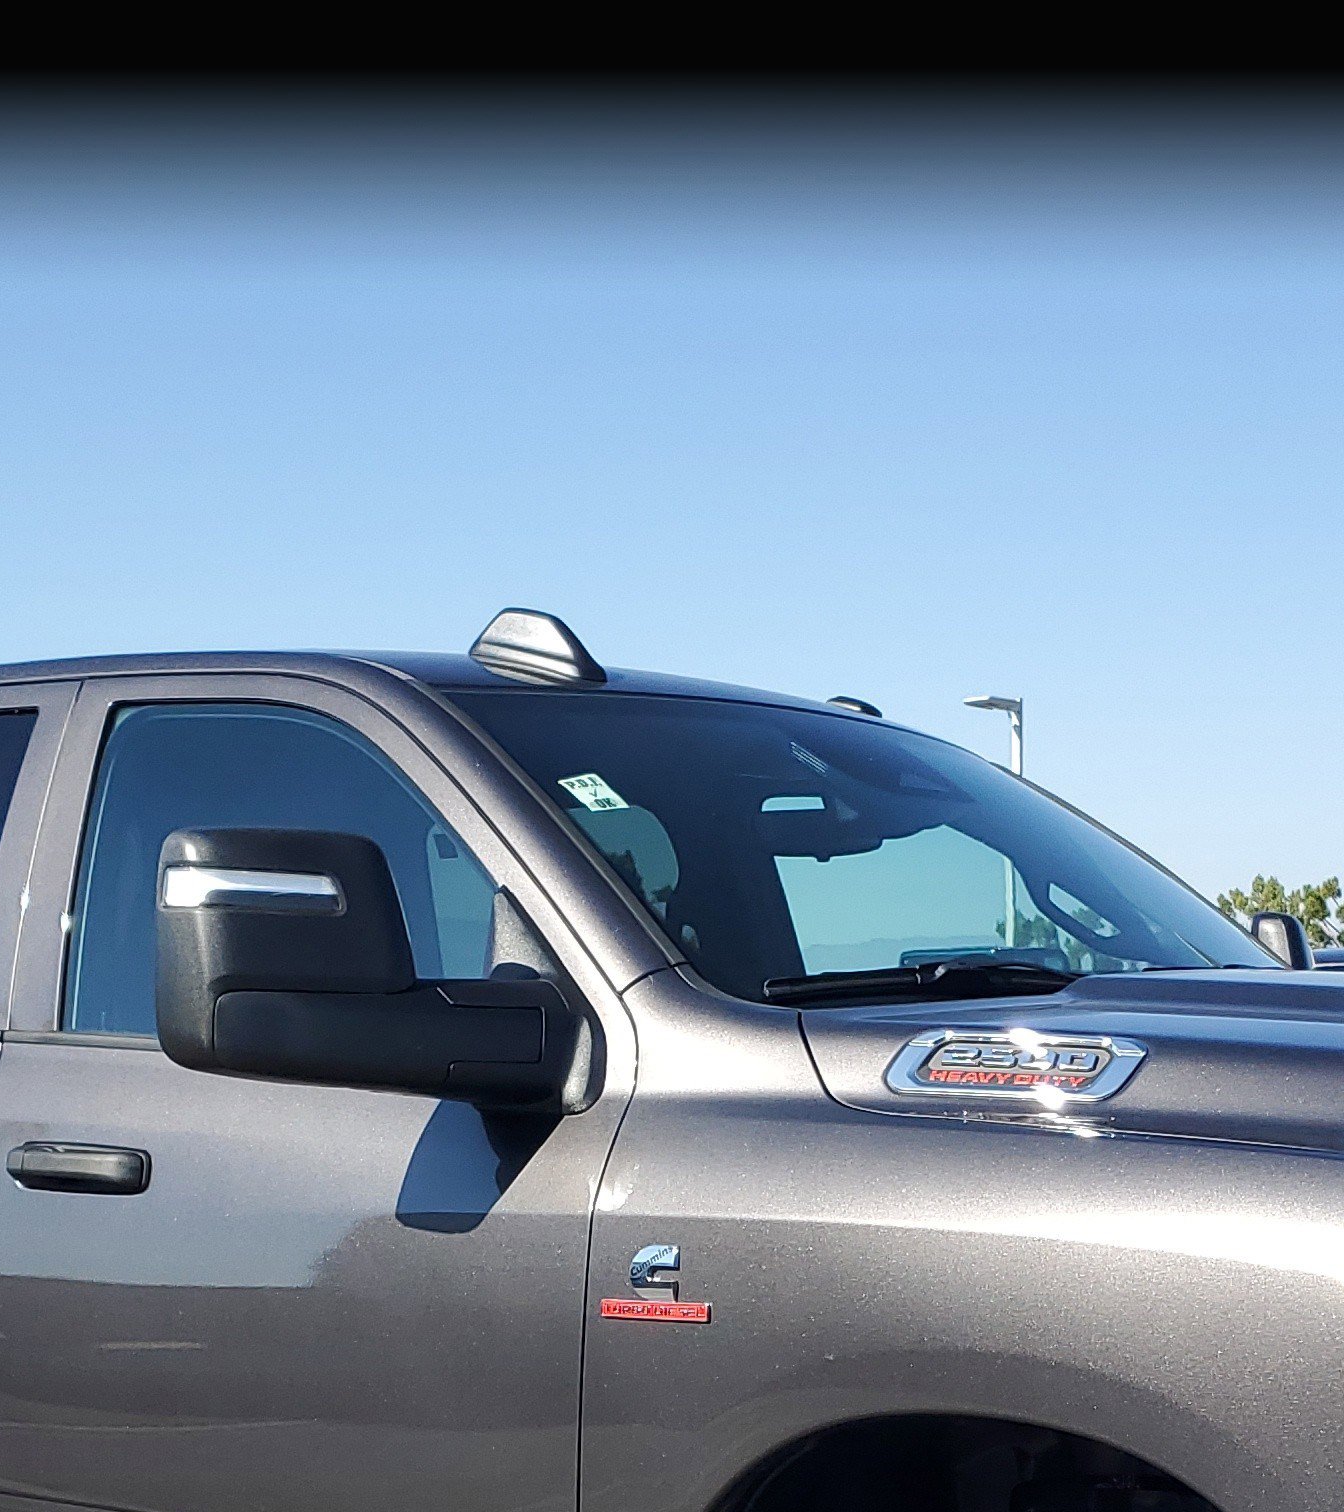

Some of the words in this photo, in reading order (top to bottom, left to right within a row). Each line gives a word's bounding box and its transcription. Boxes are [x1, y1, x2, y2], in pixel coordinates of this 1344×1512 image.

[593, 797, 617, 809] OK
[928, 1069, 1012, 1085] HEAVY
[1013, 1071, 1086, 1088] DUTY
[630, 1245, 676, 1277] Cummins
